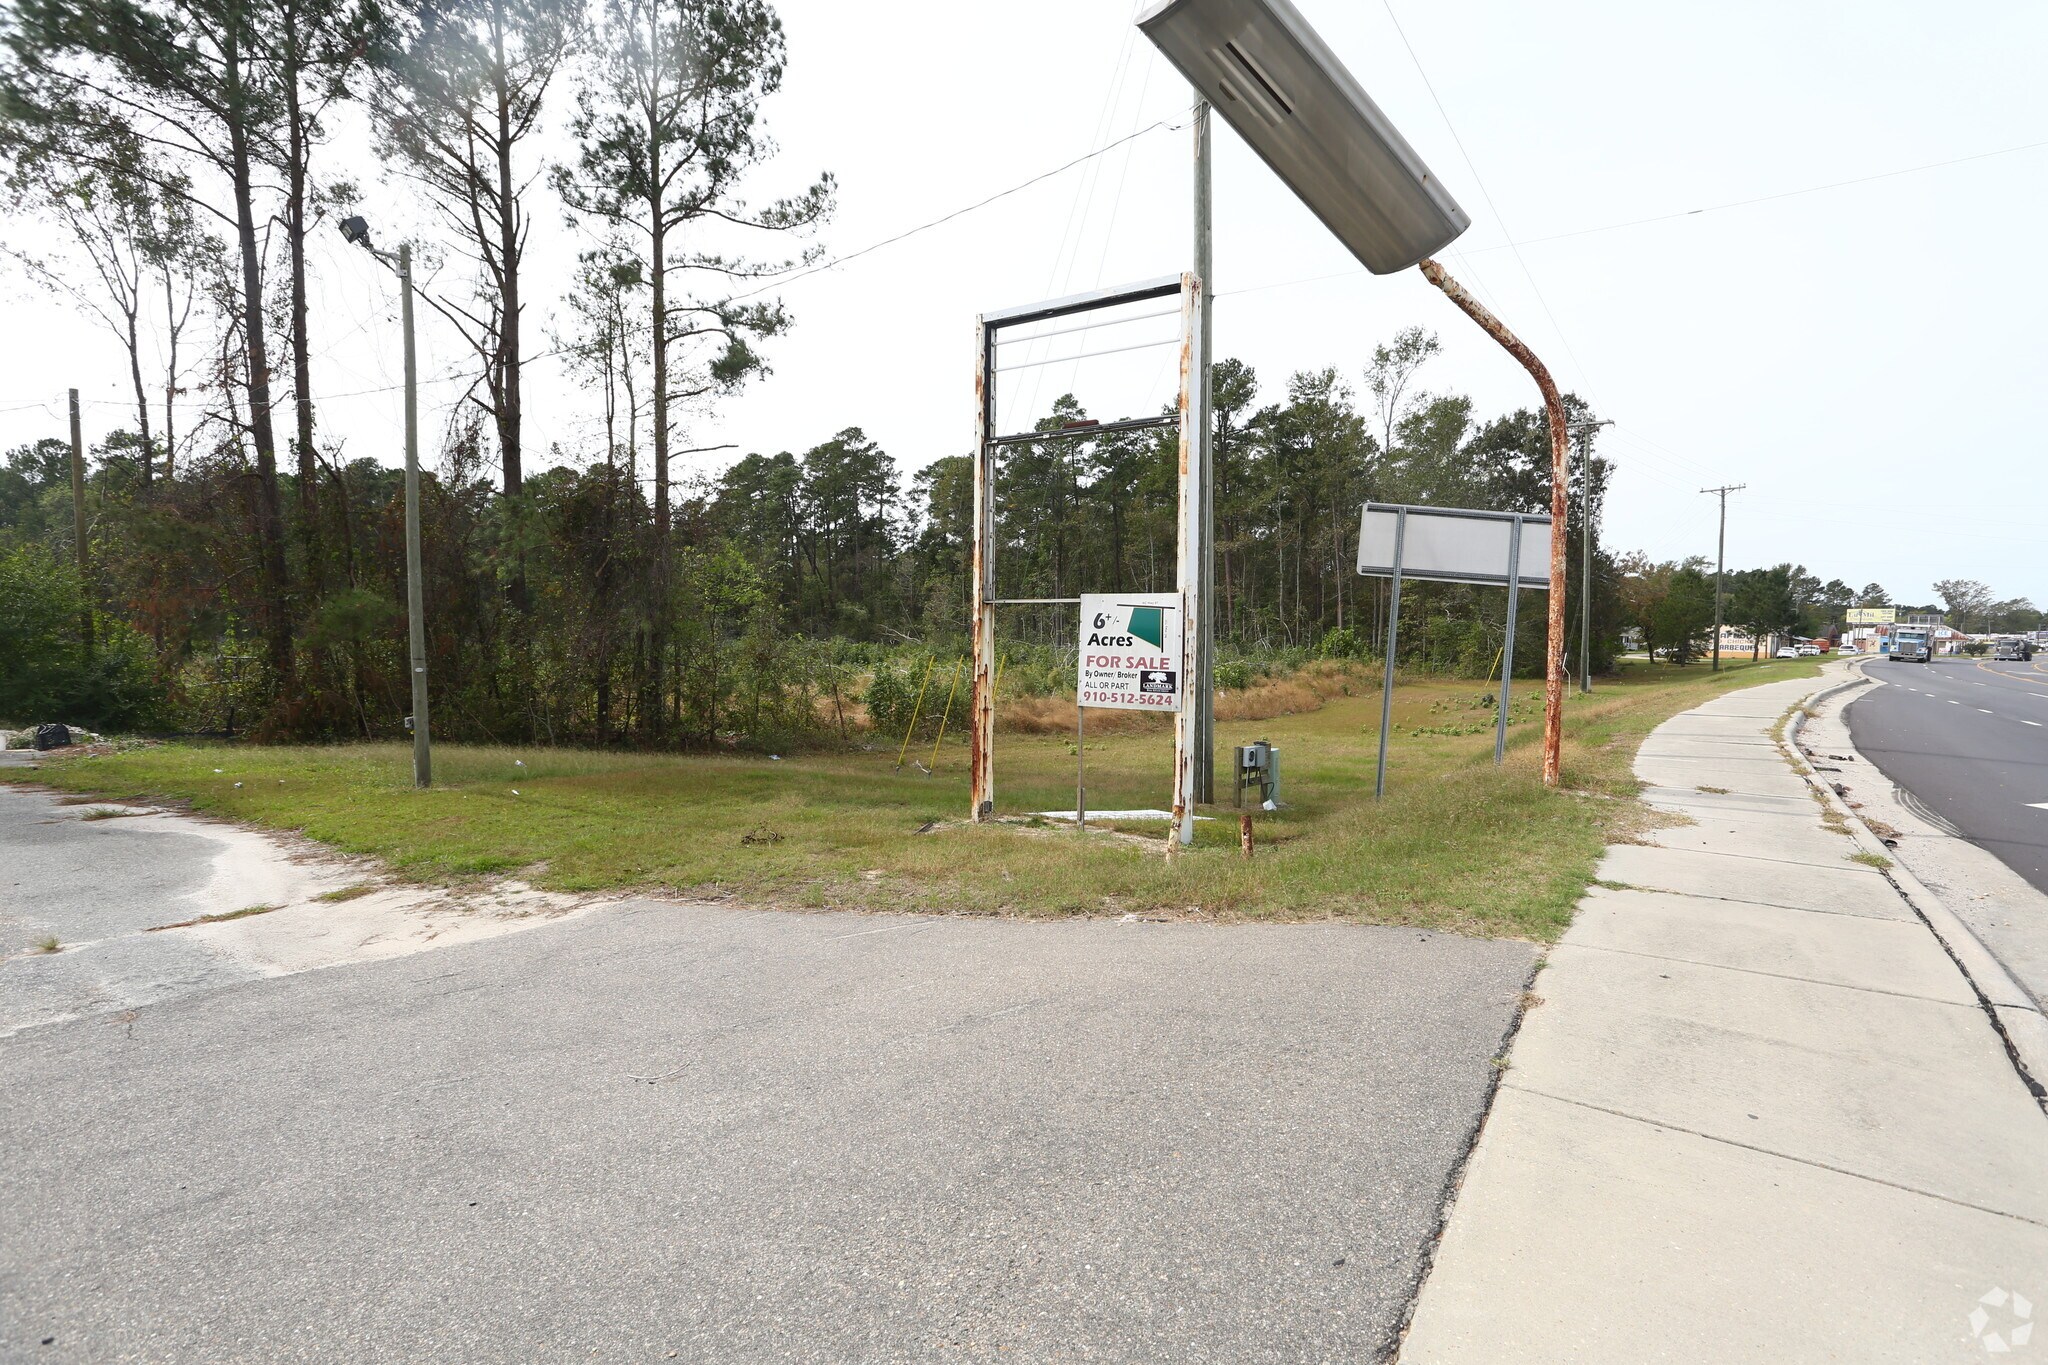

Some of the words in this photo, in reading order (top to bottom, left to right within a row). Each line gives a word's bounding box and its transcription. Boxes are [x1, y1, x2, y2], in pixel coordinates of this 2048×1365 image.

[1087, 633, 1133, 646] Acres
[1086, 656, 1121, 668] FOR
[1126, 657, 1170, 670] SALE
[1085, 670, 1092, 678] By
[1118, 671, 1137, 679] Broker
[1084, 691, 1172, 705] 910-512-5624
